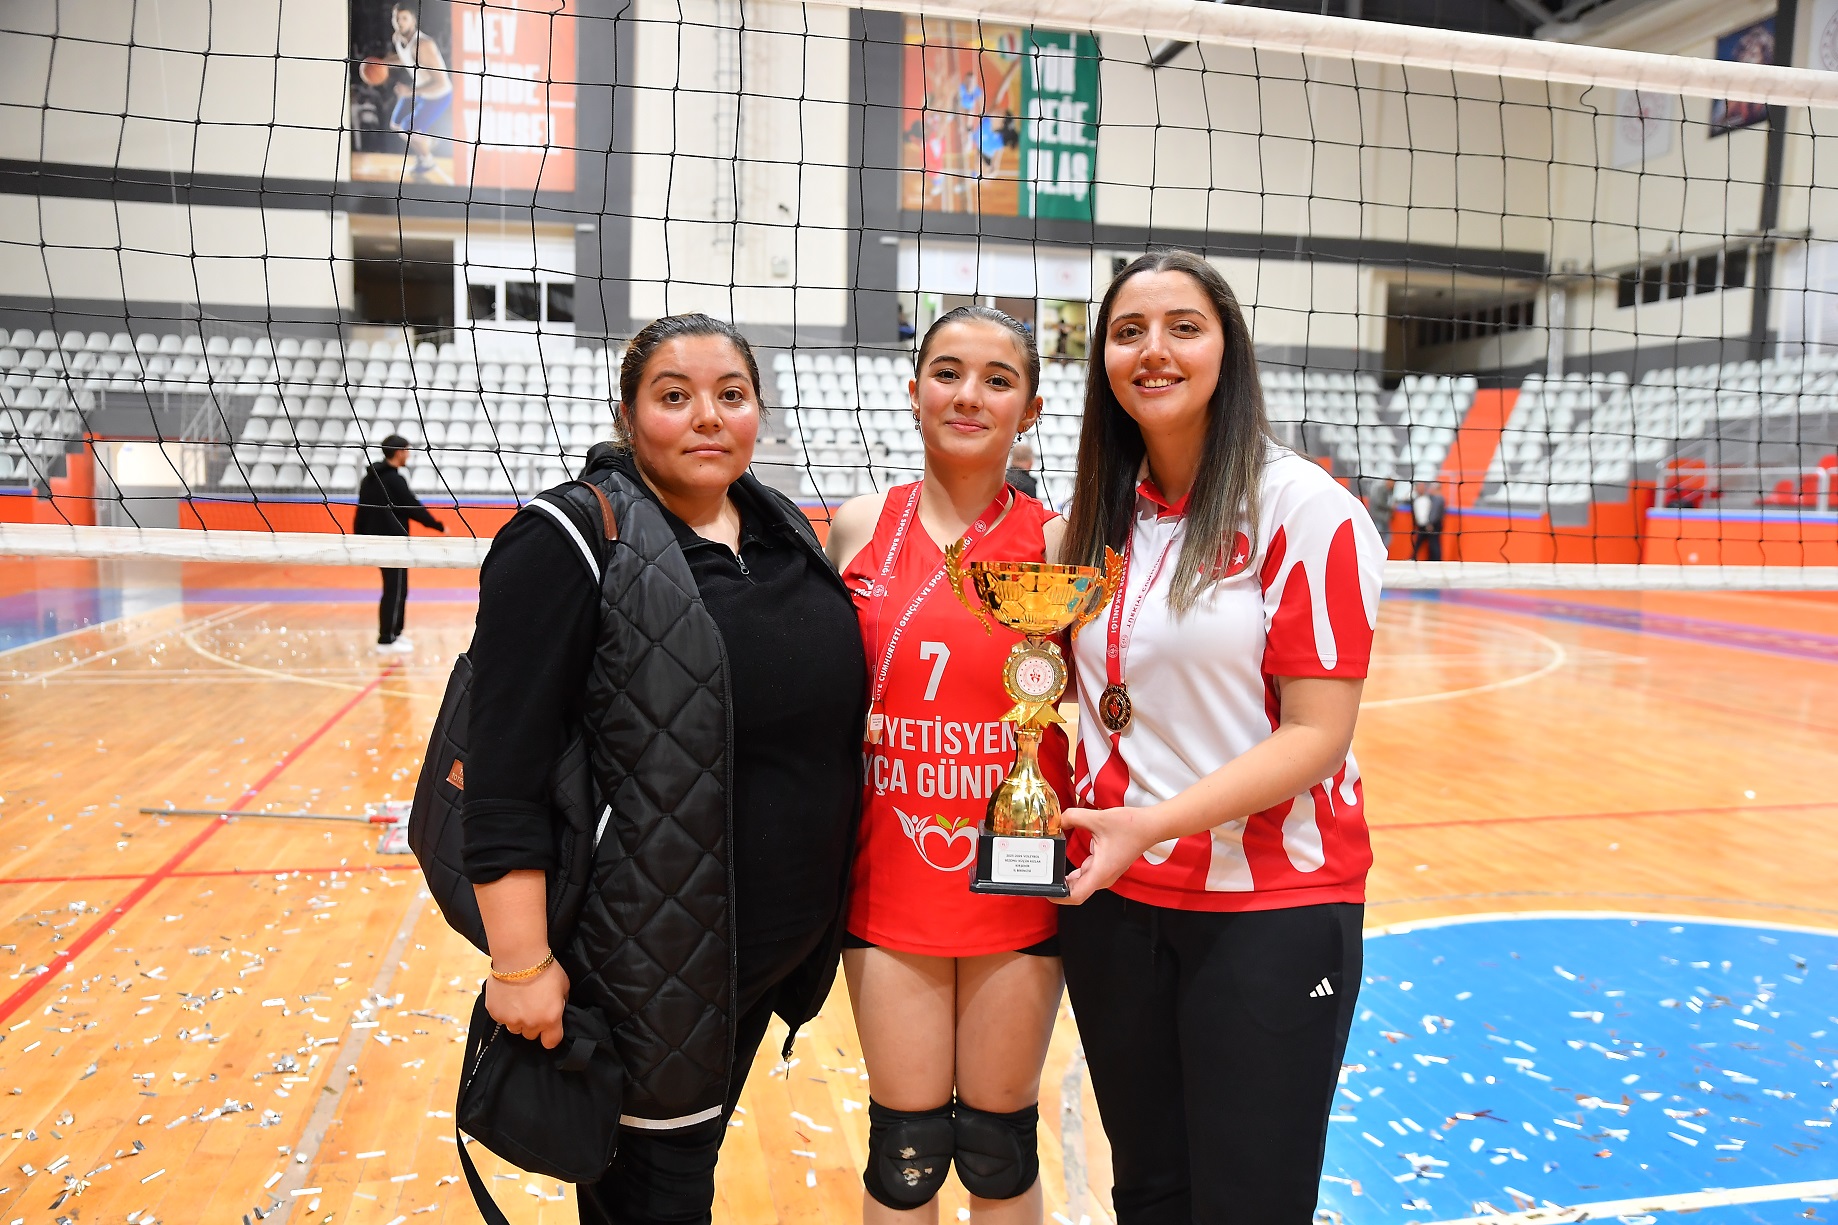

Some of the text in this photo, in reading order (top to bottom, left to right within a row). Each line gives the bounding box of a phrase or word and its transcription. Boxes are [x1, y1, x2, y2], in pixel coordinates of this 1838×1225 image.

[895, 518, 907, 537] SPOR
[881, 538, 900, 576] BAKANLIĞI
[878, 626, 903, 682] CUMHURİYETİ
[899, 595, 924, 627] GENÇLİK
[921, 586, 932, 597] VE
[928, 570, 946, 588] SPOR
[1111, 588, 1123, 633] BAKANLIĞI
[919, 641, 951, 701] 7
[864, 715, 1019, 755] YETİSYEN
[862, 754, 1015, 800] YÇA GÜND
